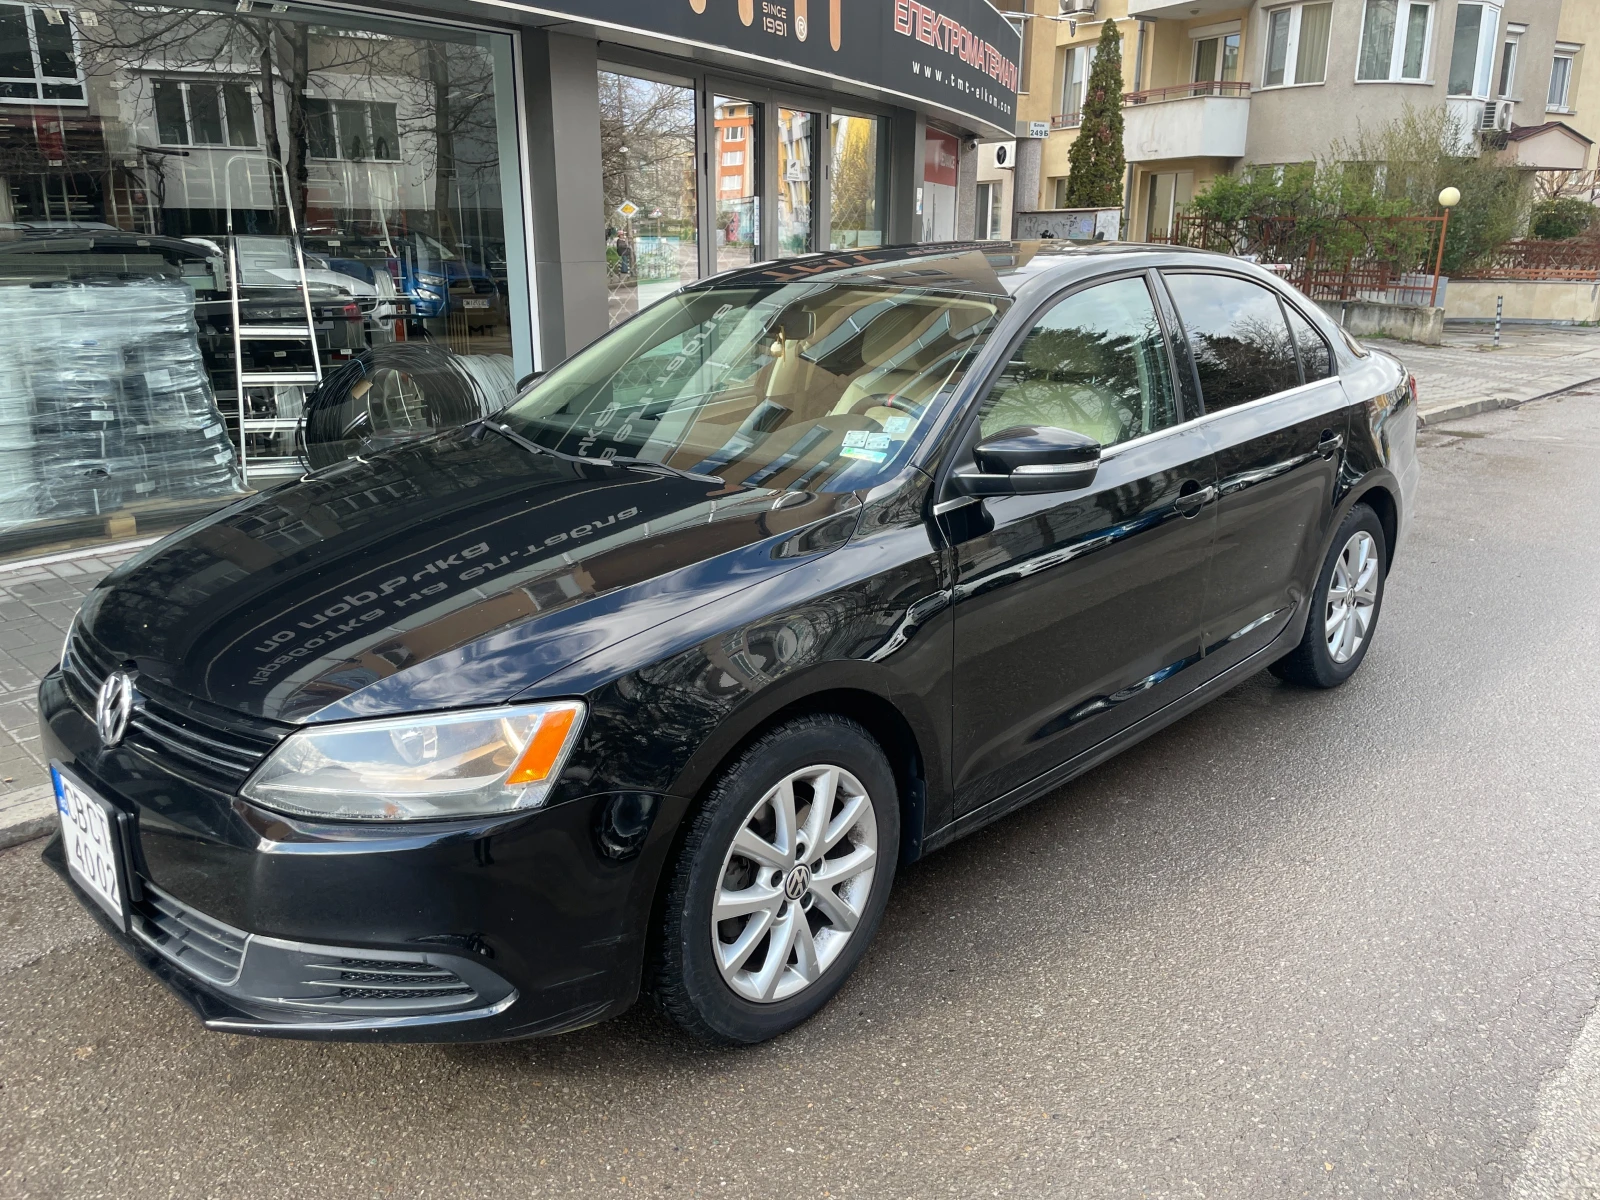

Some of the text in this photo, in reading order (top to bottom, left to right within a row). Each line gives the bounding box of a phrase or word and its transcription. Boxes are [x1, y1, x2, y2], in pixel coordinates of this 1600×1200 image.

[762, 1, 787, 19] SINCE
[762, 16, 787, 37] 1991
[893, 0, 1018, 94] ЕЛЕКТРОМАТЕРИАЛИ
[912, 60, 1011, 115] www.tmt-elkom.com
[76, 834, 120, 907] 4002
